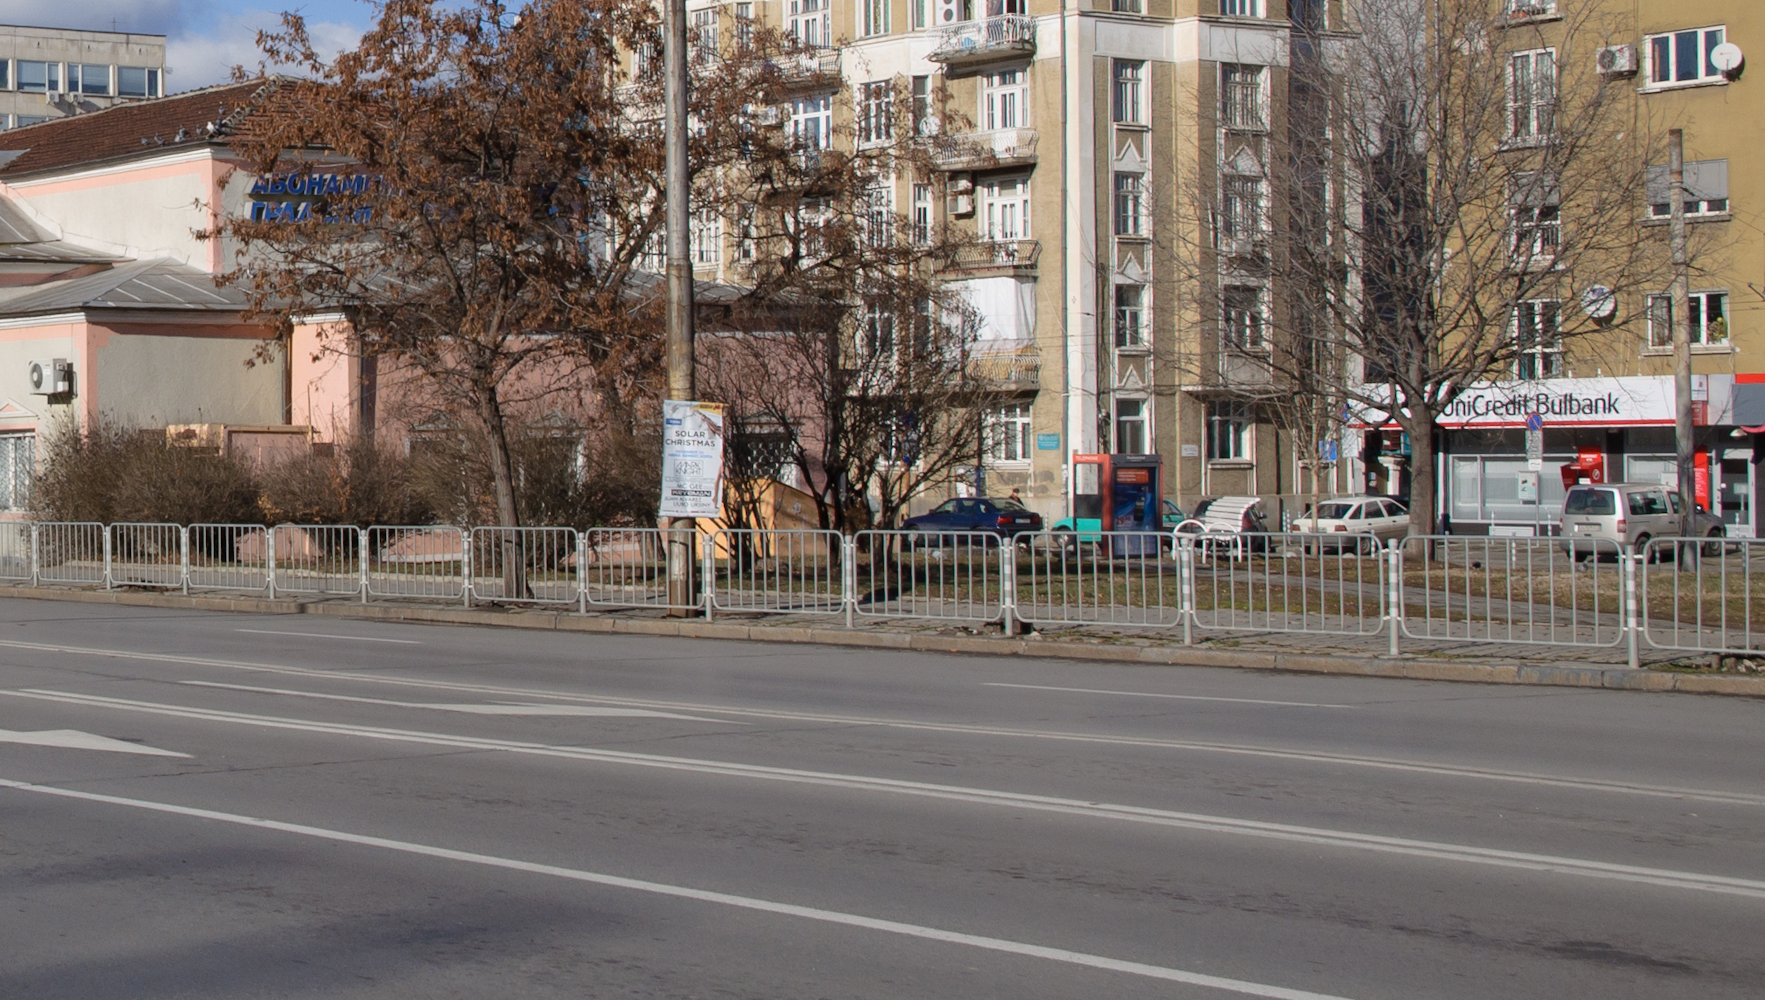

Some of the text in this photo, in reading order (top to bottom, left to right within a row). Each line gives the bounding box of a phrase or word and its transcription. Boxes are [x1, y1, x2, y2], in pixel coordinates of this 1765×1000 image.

[1536, 392, 1620, 416] Bulbank
[675, 430, 705, 438] SOLAR
[665, 438, 716, 447] CHRISTMAS
